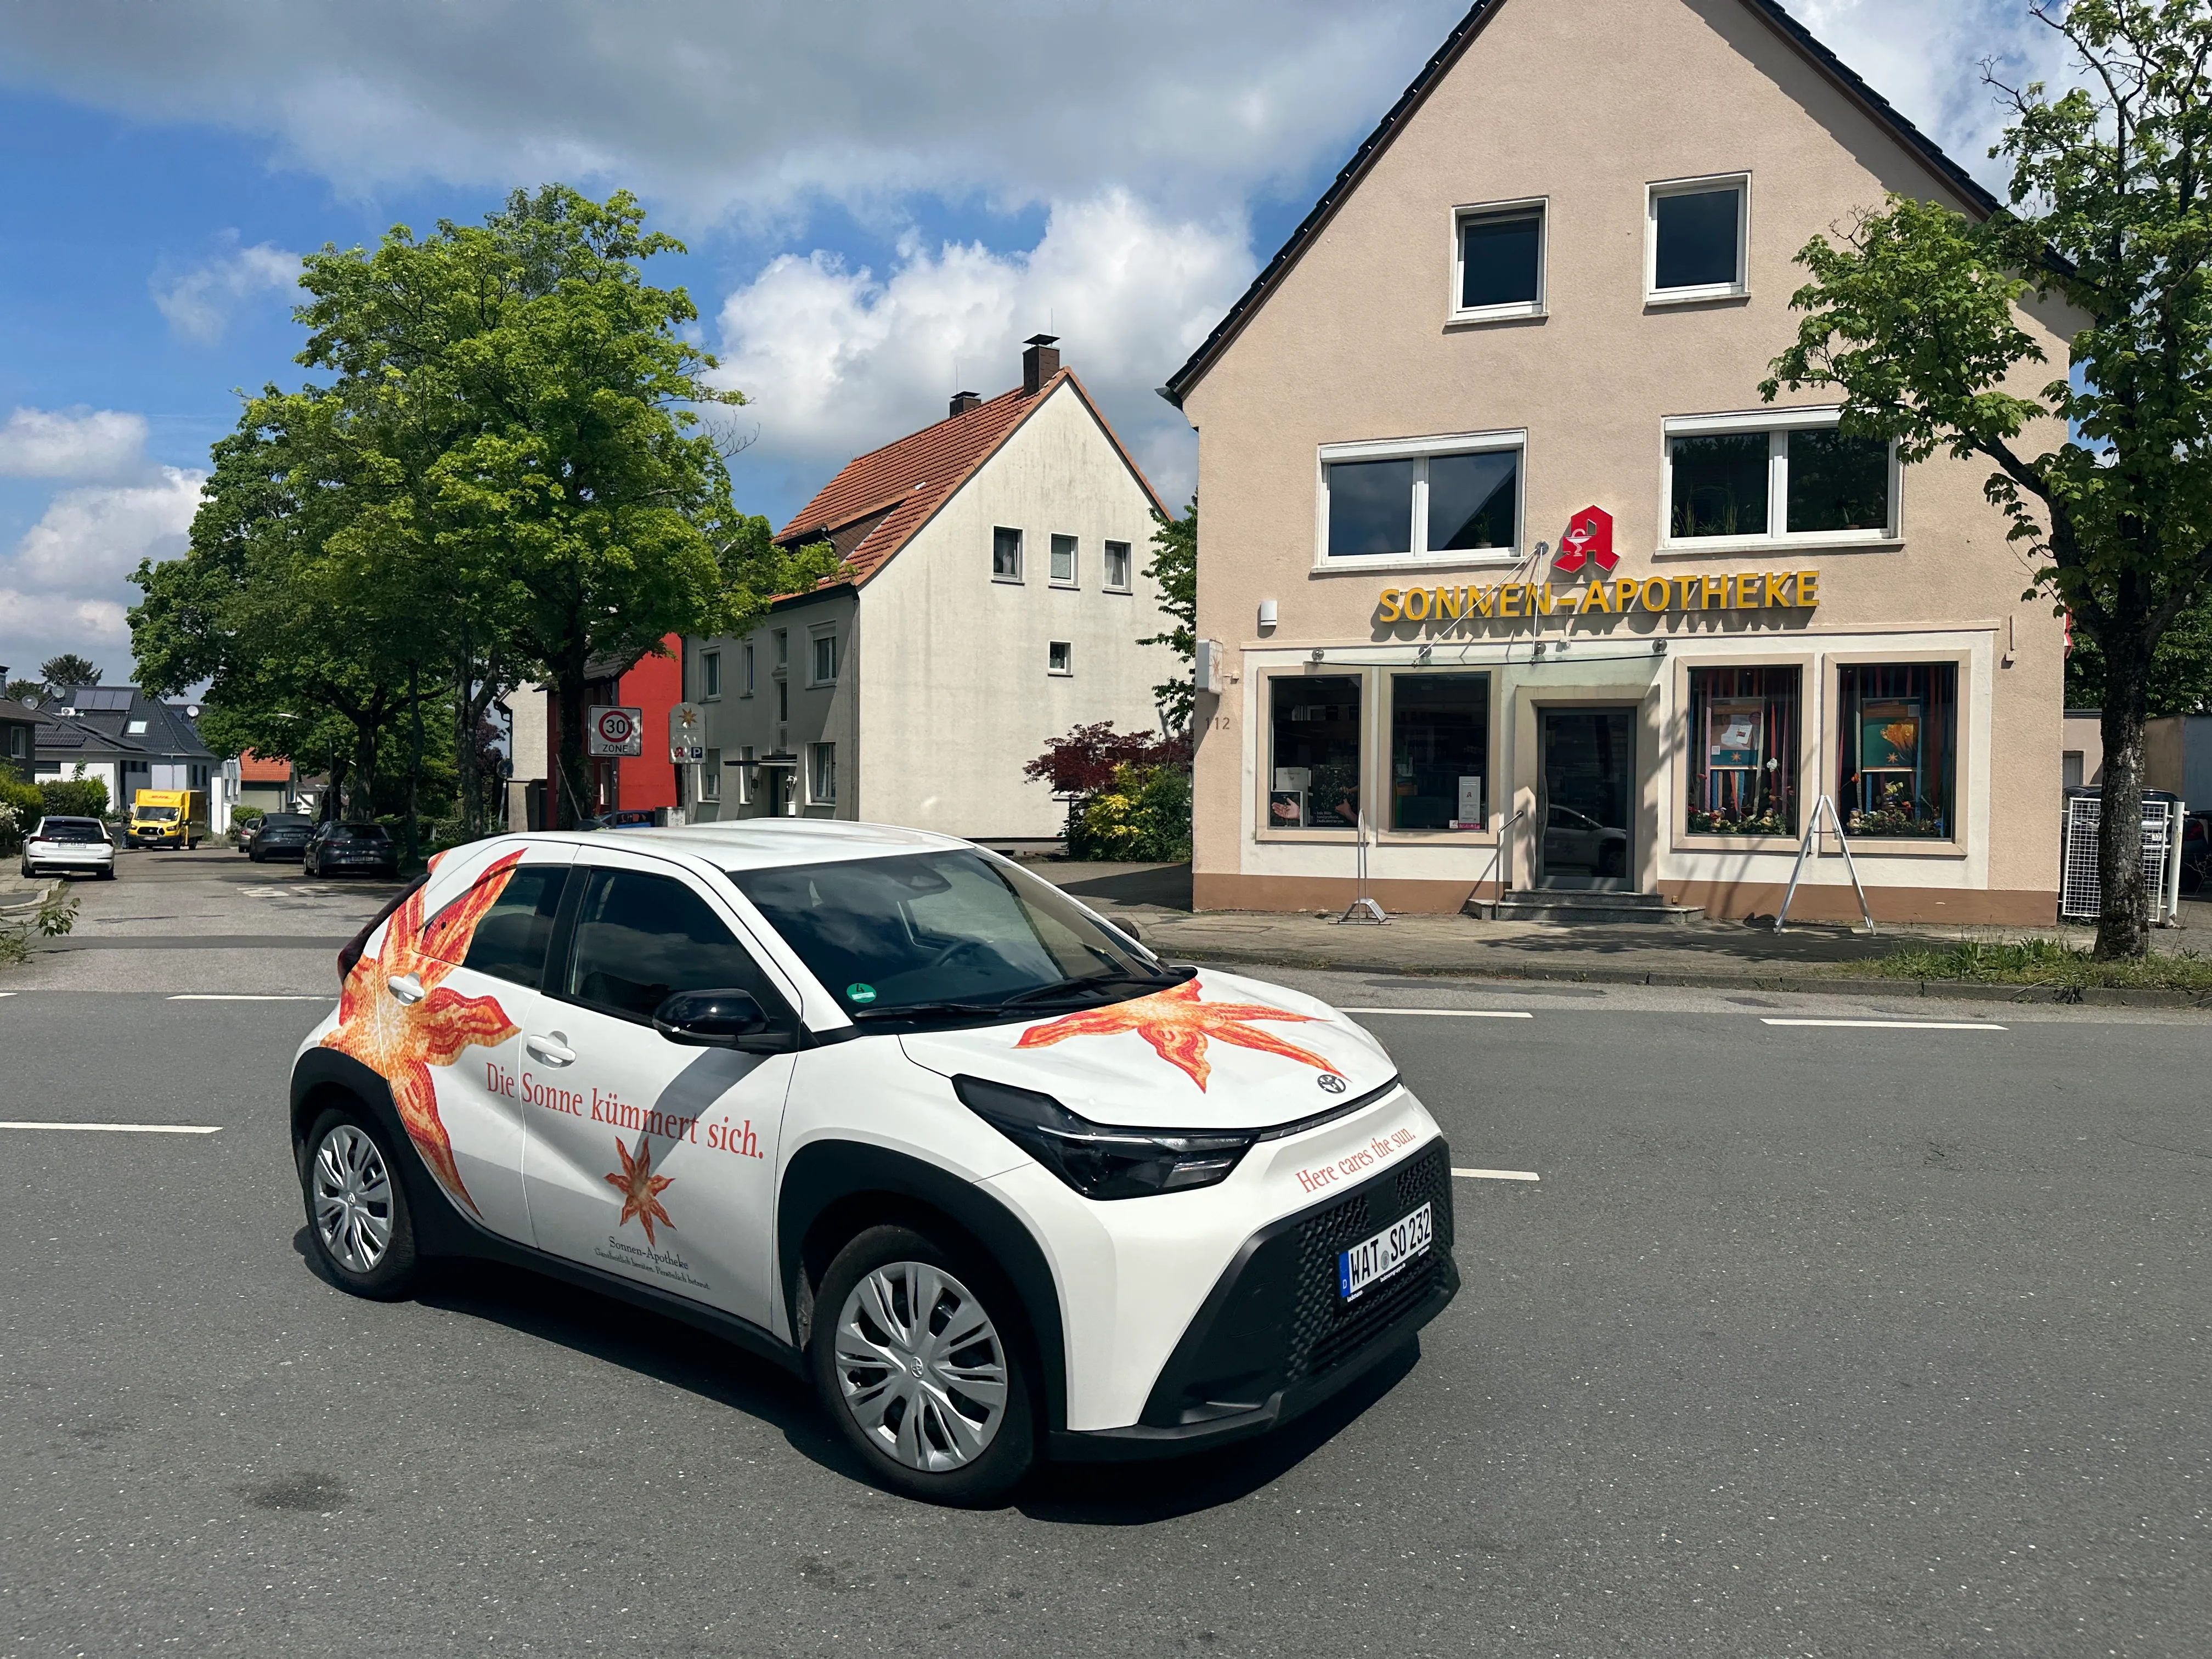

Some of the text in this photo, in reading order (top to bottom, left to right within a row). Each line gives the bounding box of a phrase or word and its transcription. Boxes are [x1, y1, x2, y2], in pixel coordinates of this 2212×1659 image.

[1379, 571, 1820, 622] SONNEN-APOTHEKE
[606, 719, 625, 734] 30
[1205, 717, 1229, 730] 112
[602, 744, 628, 753] ZONE
[693, 748, 701, 758] P
[856, 984, 865, 992] 4
[486, 1062, 764, 1159] Die Sonne kümmert sich.
[1295, 1128, 1416, 1193] Here cares the sun.
[608, 1236, 689, 1270] Sonnen-Apotheke
[1351, 1208, 1430, 1286] WAT SO 232
[1342, 1279, 1347, 1289] D
